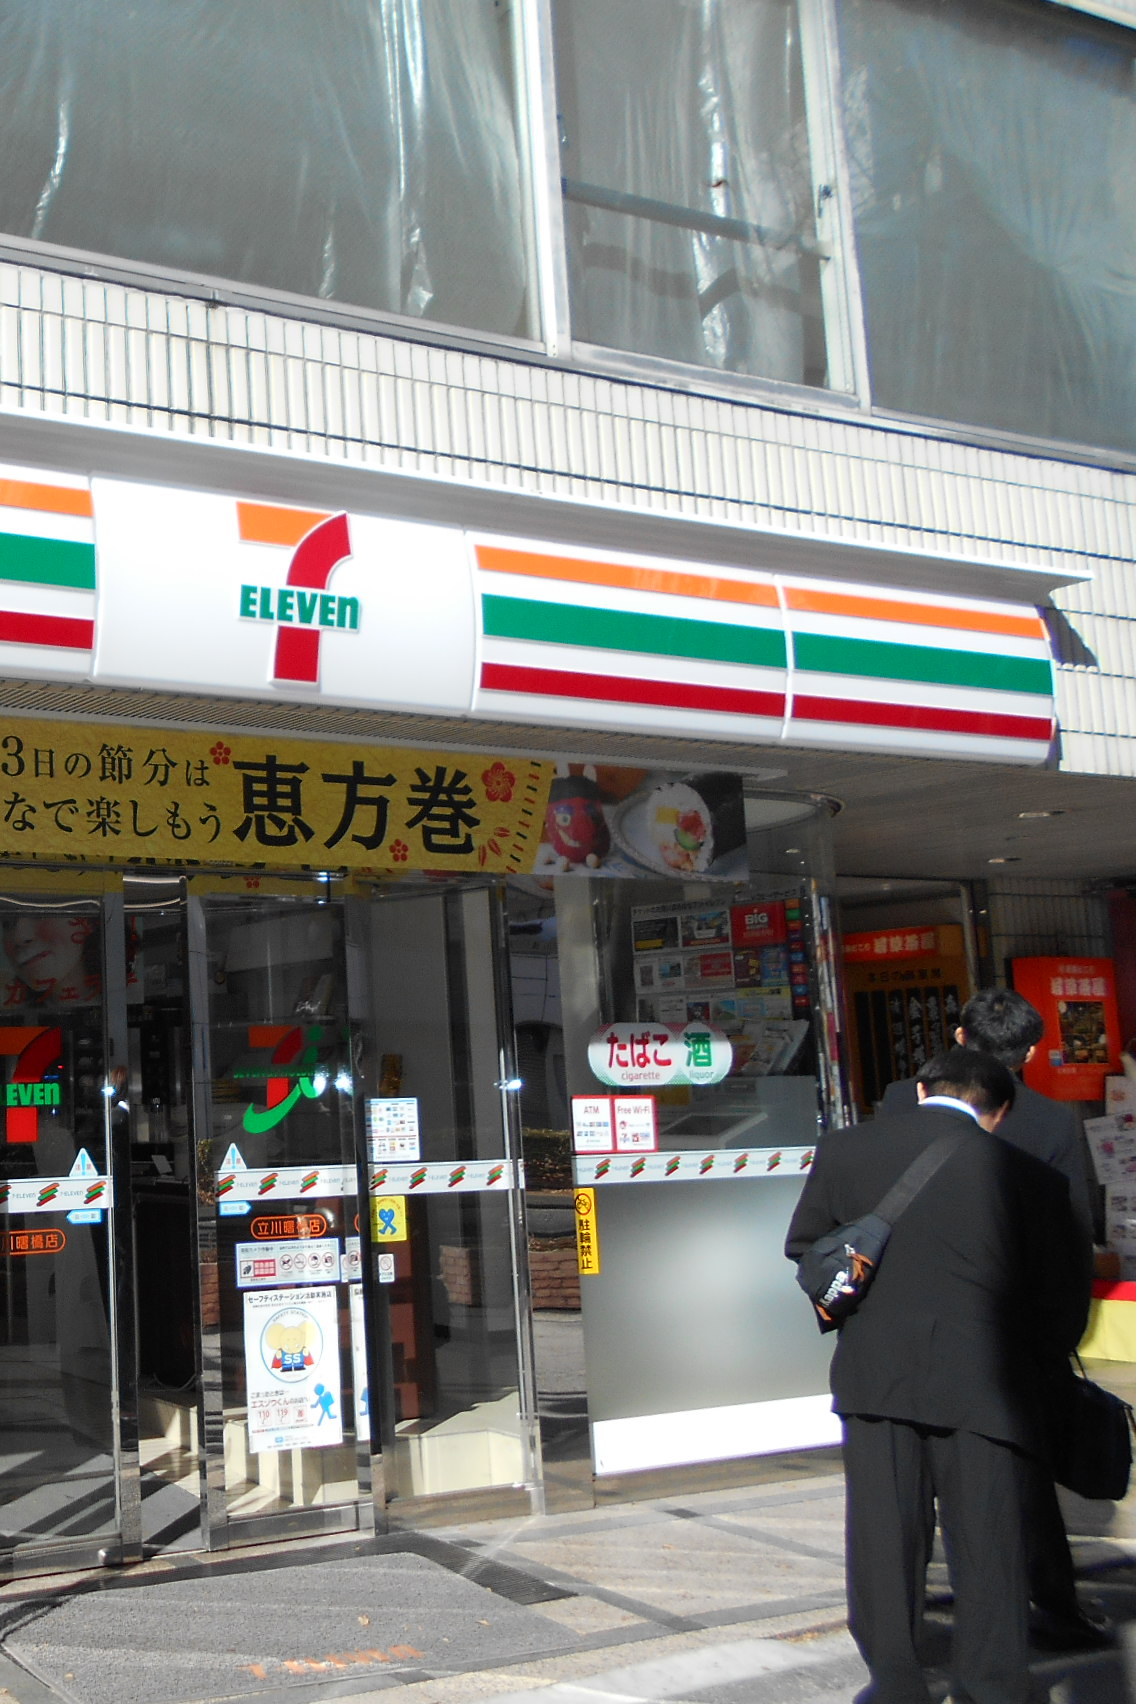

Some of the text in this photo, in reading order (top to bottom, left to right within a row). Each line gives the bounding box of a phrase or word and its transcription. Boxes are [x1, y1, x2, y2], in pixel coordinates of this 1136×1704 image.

[231, 753, 482, 855] 恵方巻
[606, 1031, 672, 1068] たばこ
[683, 1031, 712, 1067] 酒
[621, 1071, 660, 1082] cigarette
[689, 1069, 714, 1081] liquor
[583, 1106, 600, 1114] ATM
[617, 1105, 651, 1114] Free Wi-Fi
[578, 1219, 593, 1270] 駐輪禁止
[283, 1354, 301, 1364] SS
